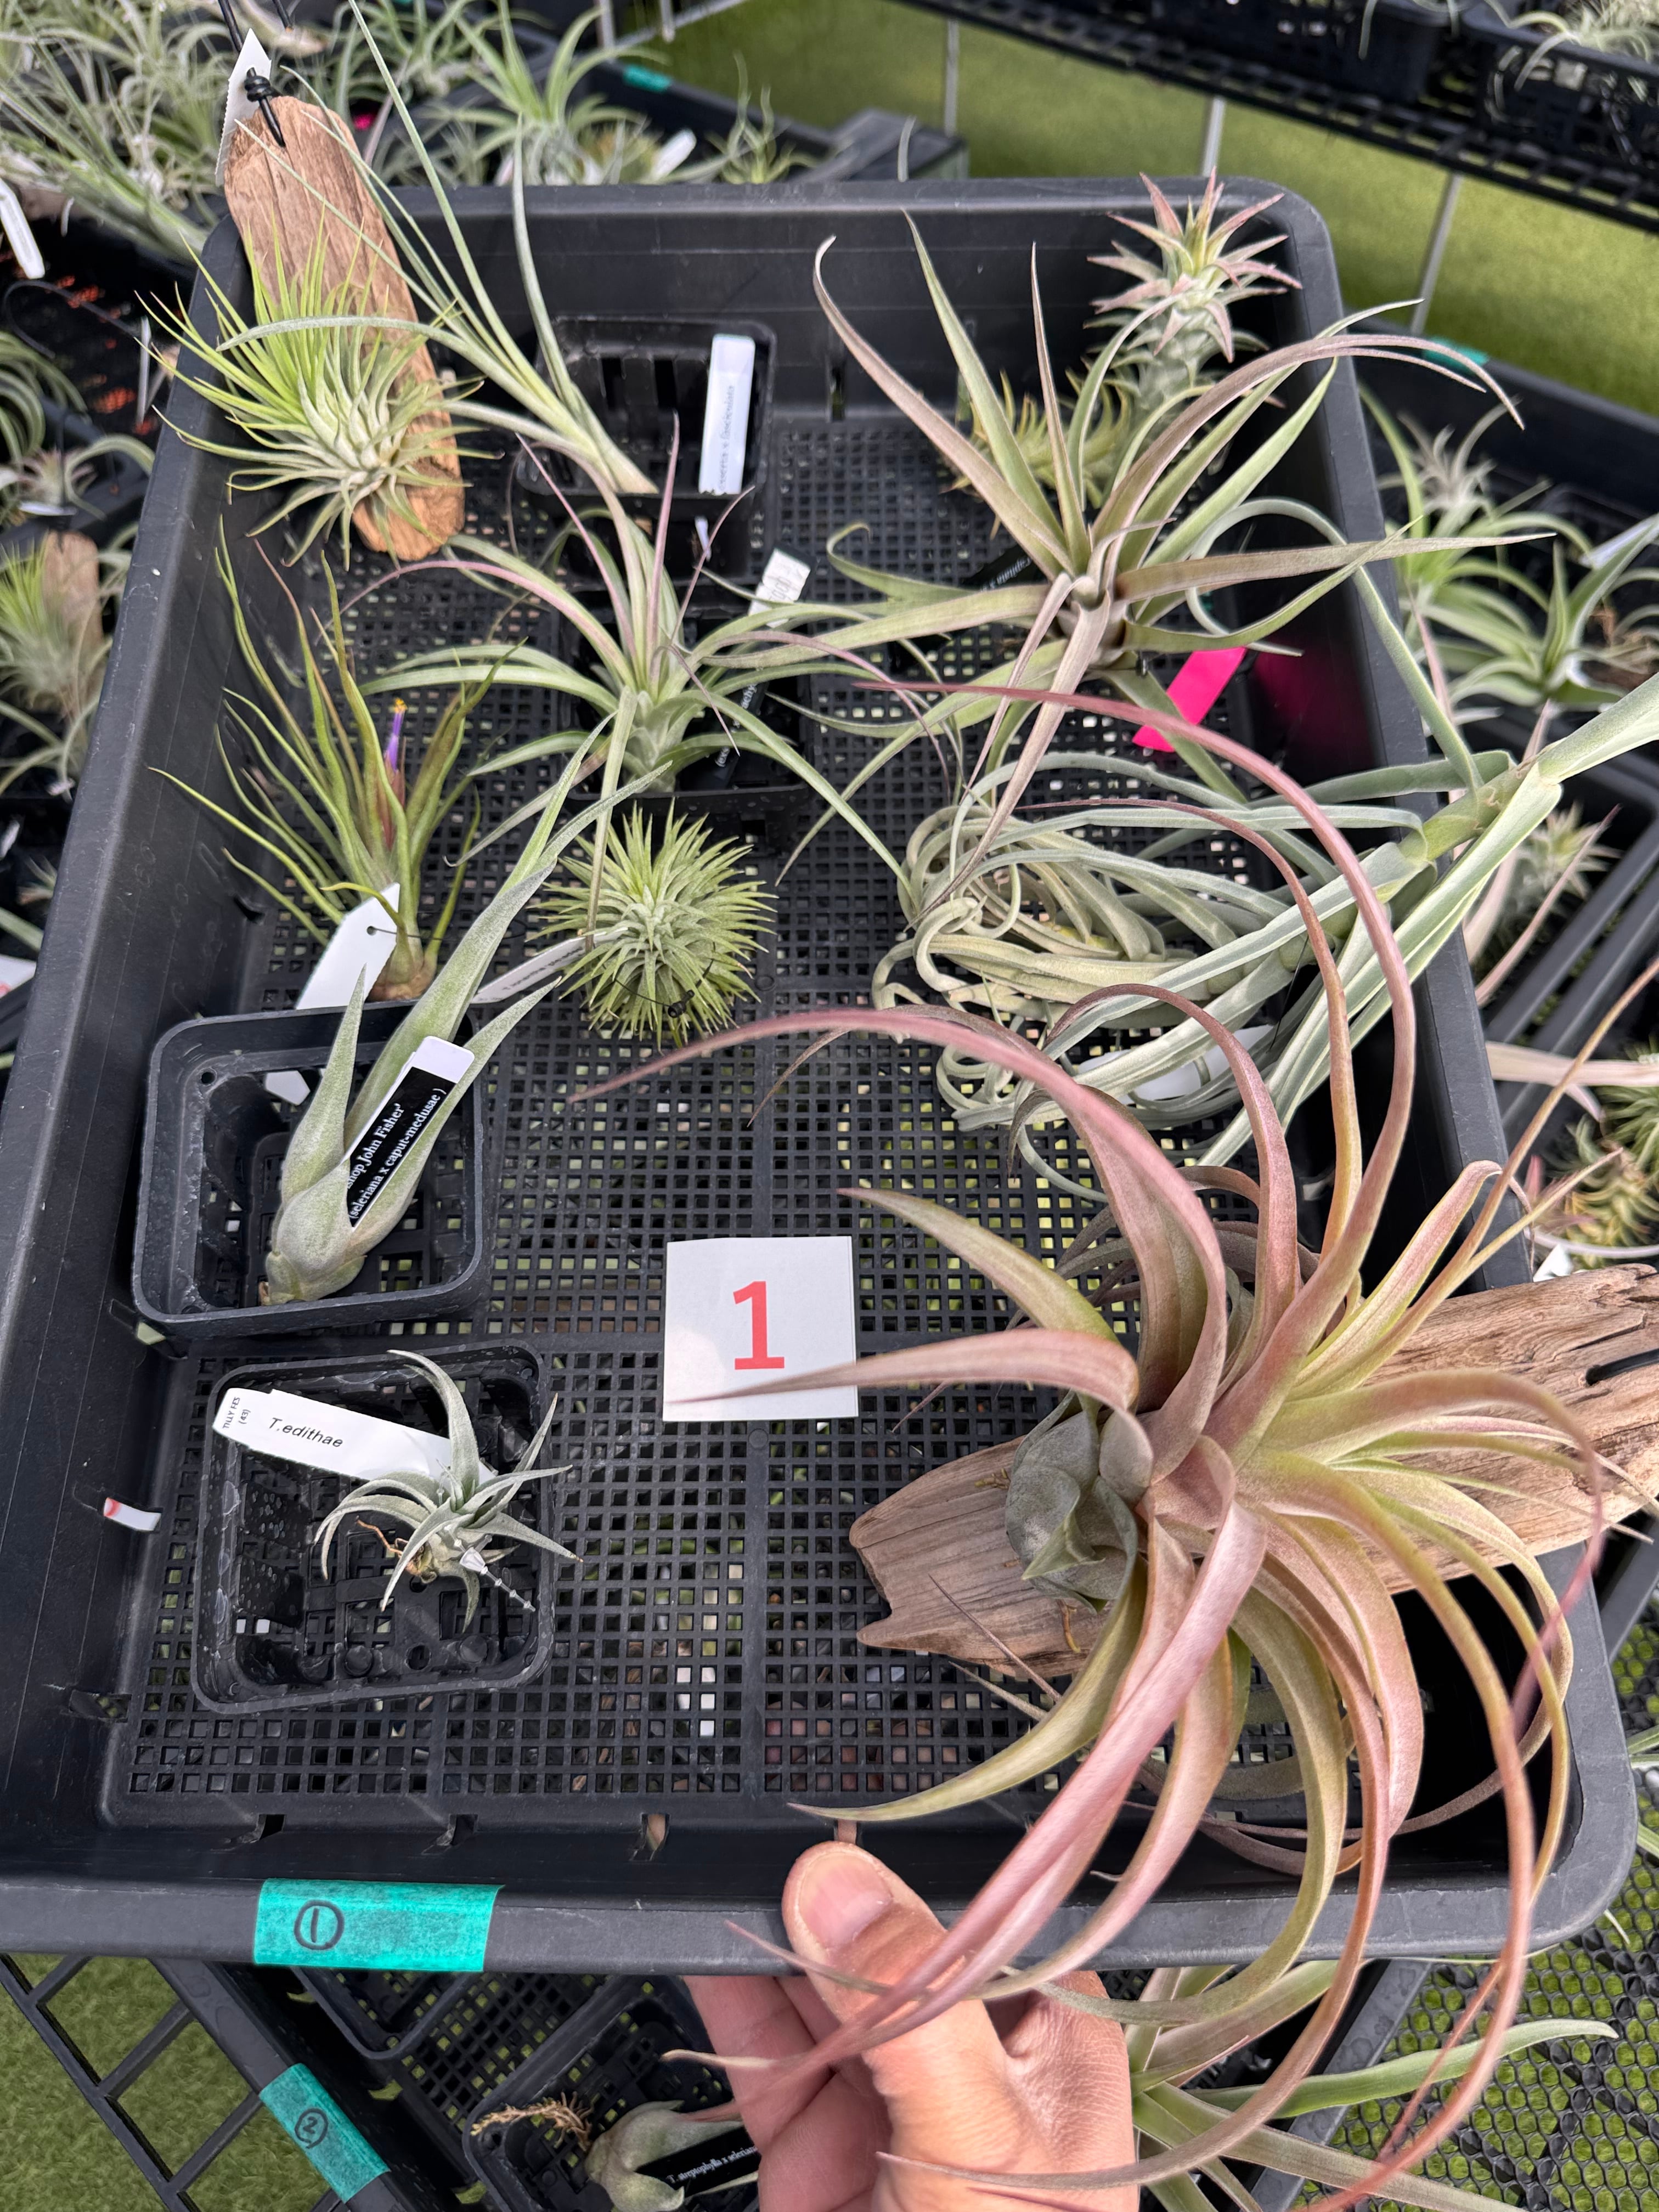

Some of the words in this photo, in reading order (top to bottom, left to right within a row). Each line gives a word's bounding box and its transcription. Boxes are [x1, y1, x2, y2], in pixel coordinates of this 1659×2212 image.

[349, 1175, 384, 1219] (seleriana
[377, 1166, 390, 1176] x
[385, 1094, 441, 1167] caput-medusae
[356, 1139, 382, 1167] John
[733, 1280, 785, 1370] 1
[232, 1396, 240, 1409] FES
[269, 1417, 343, 1447] T.edithae
